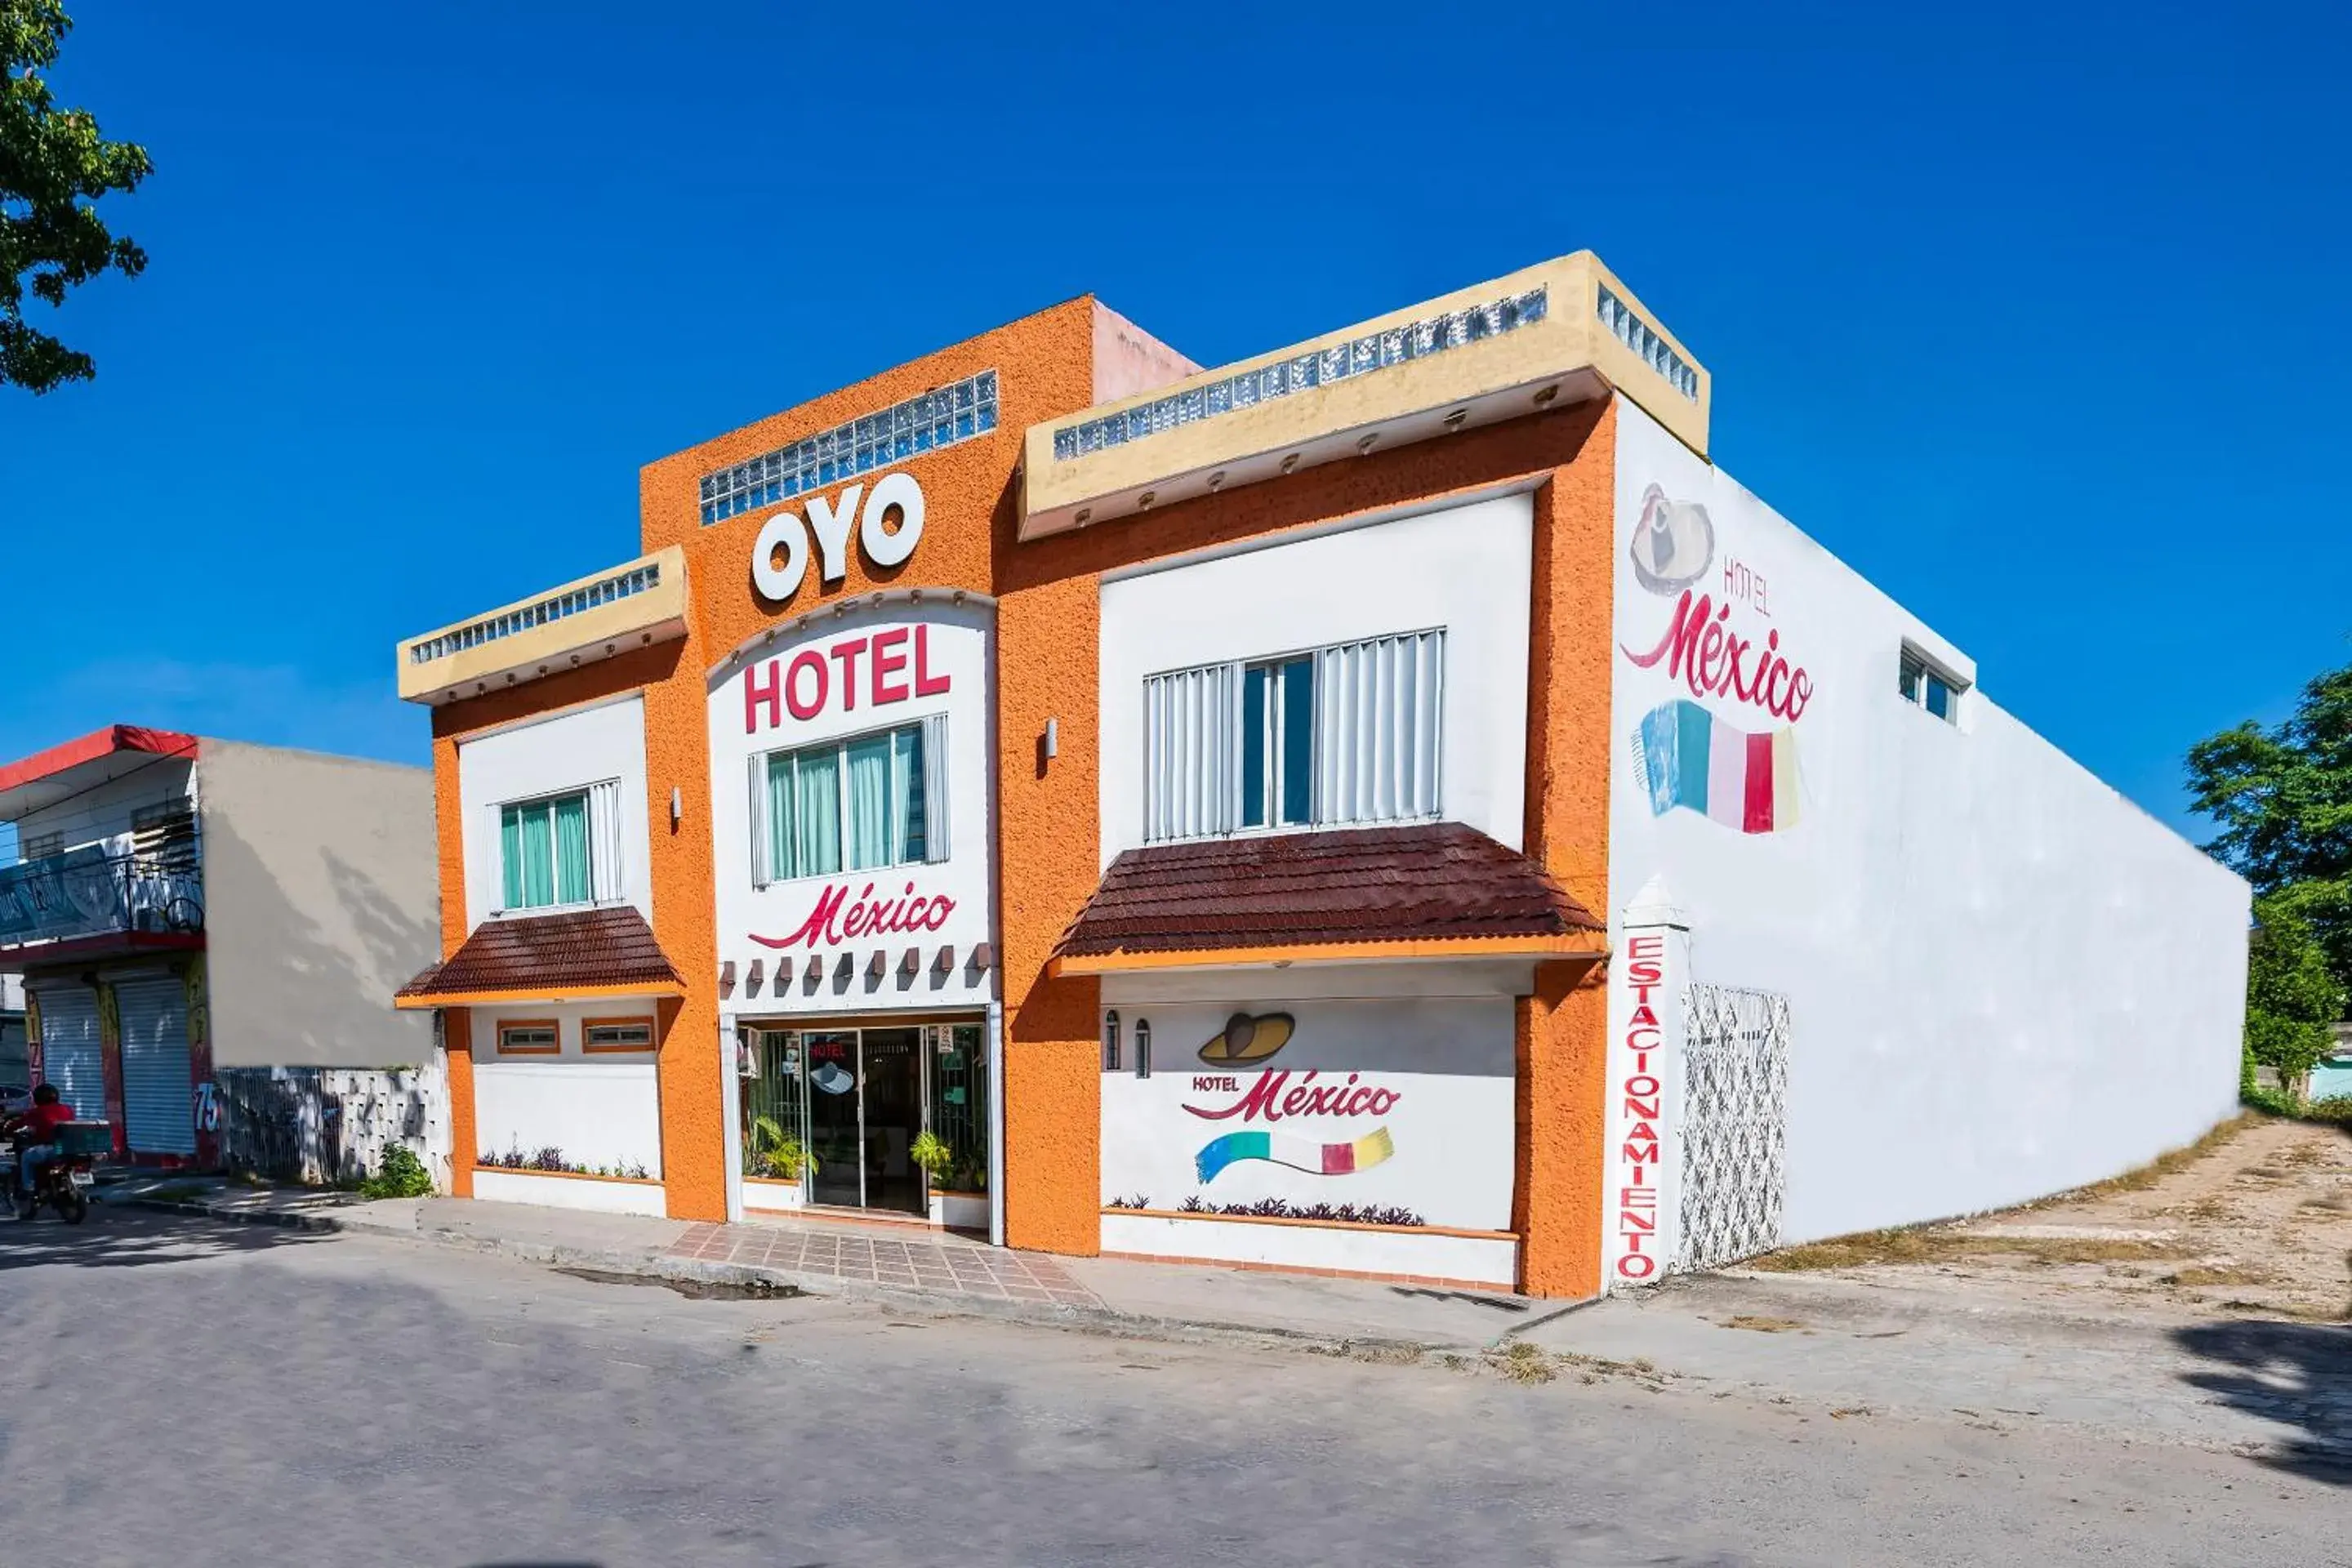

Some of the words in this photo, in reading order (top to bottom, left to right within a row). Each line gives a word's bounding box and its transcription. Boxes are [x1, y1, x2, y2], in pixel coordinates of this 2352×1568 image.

[752, 472, 924, 600] OYO
[1722, 555, 1771, 618] HOTEL
[744, 623, 951, 734] HOTEL
[1619, 589, 1814, 723] México
[748, 880, 956, 949] México
[1181, 1067, 1401, 1122] México
[1192, 1076, 1240, 1092] HOTEL
[1617, 936, 1663, 1279] ESTACIONAMIENTO
